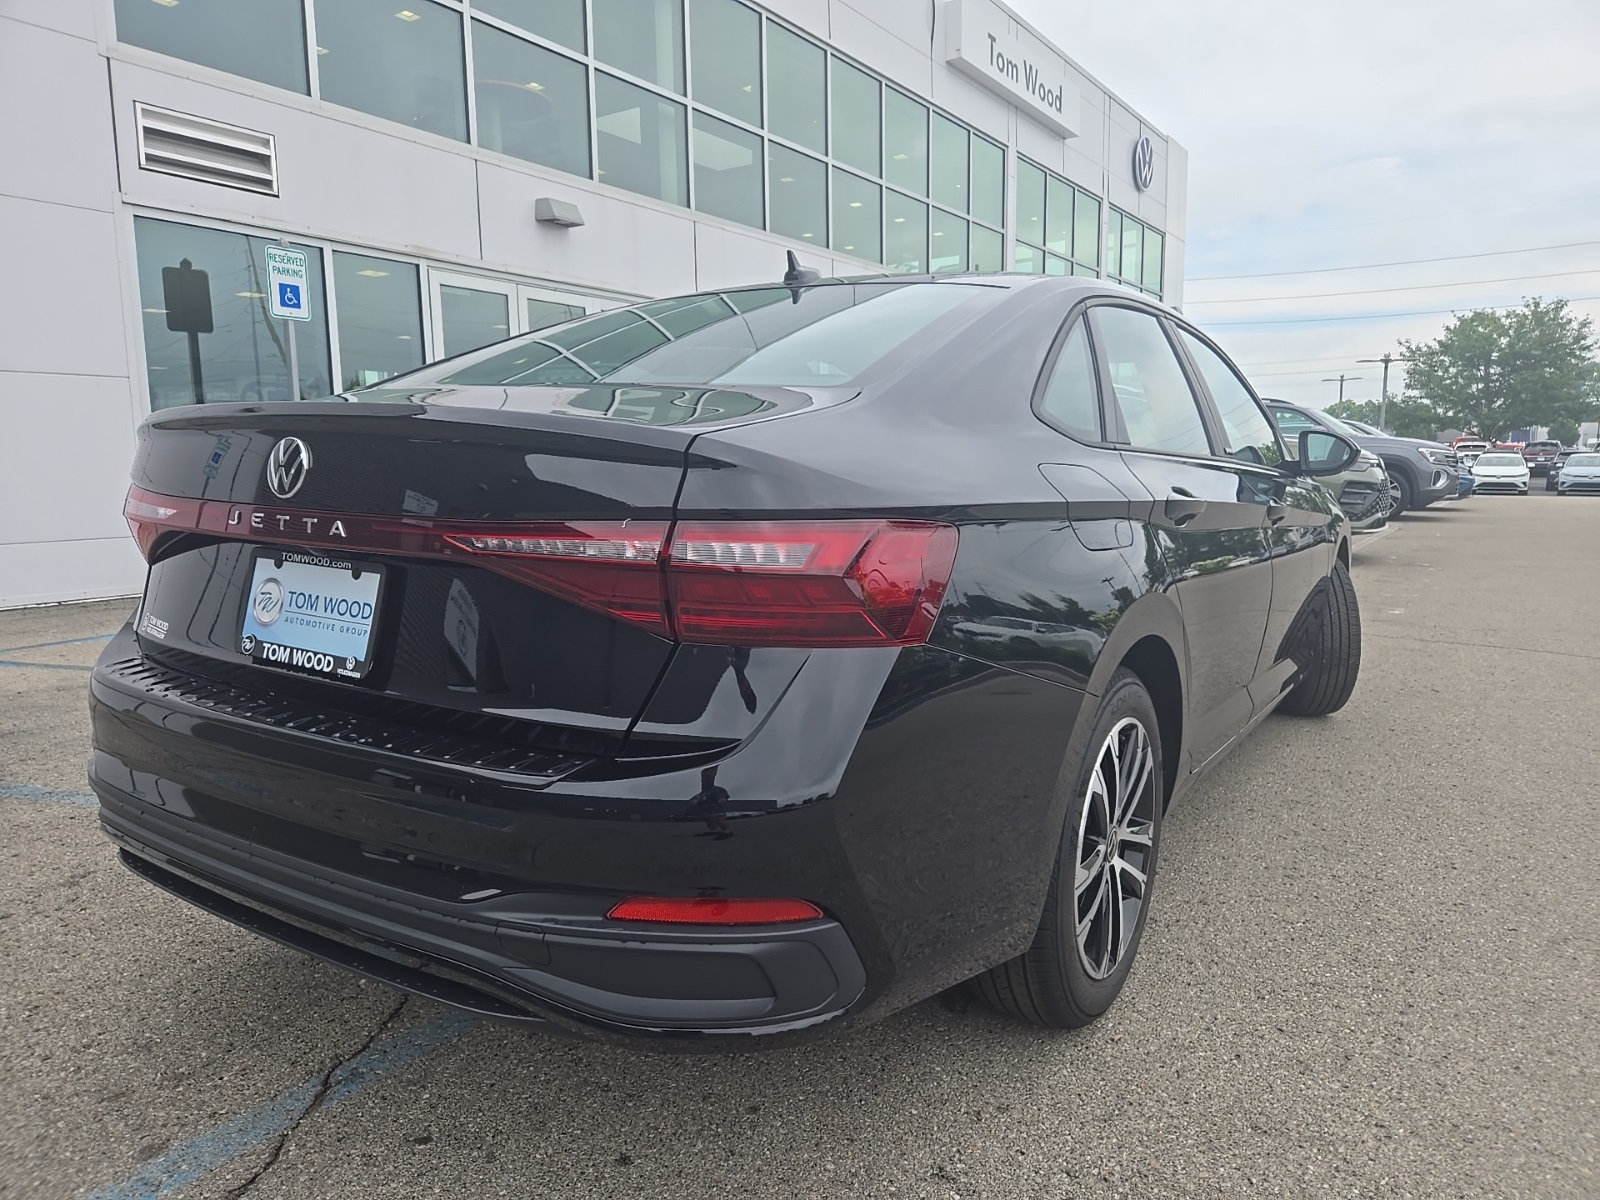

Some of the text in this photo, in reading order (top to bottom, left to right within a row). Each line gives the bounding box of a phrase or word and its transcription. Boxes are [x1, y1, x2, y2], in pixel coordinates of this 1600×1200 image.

[987, 32, 1063, 114] Tom Wood
[268, 252, 304, 268] RESERVED
[272, 265, 303, 279] PARKING
[228, 510, 347, 537] JETTA
[281, 551, 352, 569] TOMWOOD.com
[288, 590, 373, 620] TOM WOOD
[284, 615, 369, 637] AUTOMOTIVE GROUP
[262, 642, 335, 673] TOM WOOD
